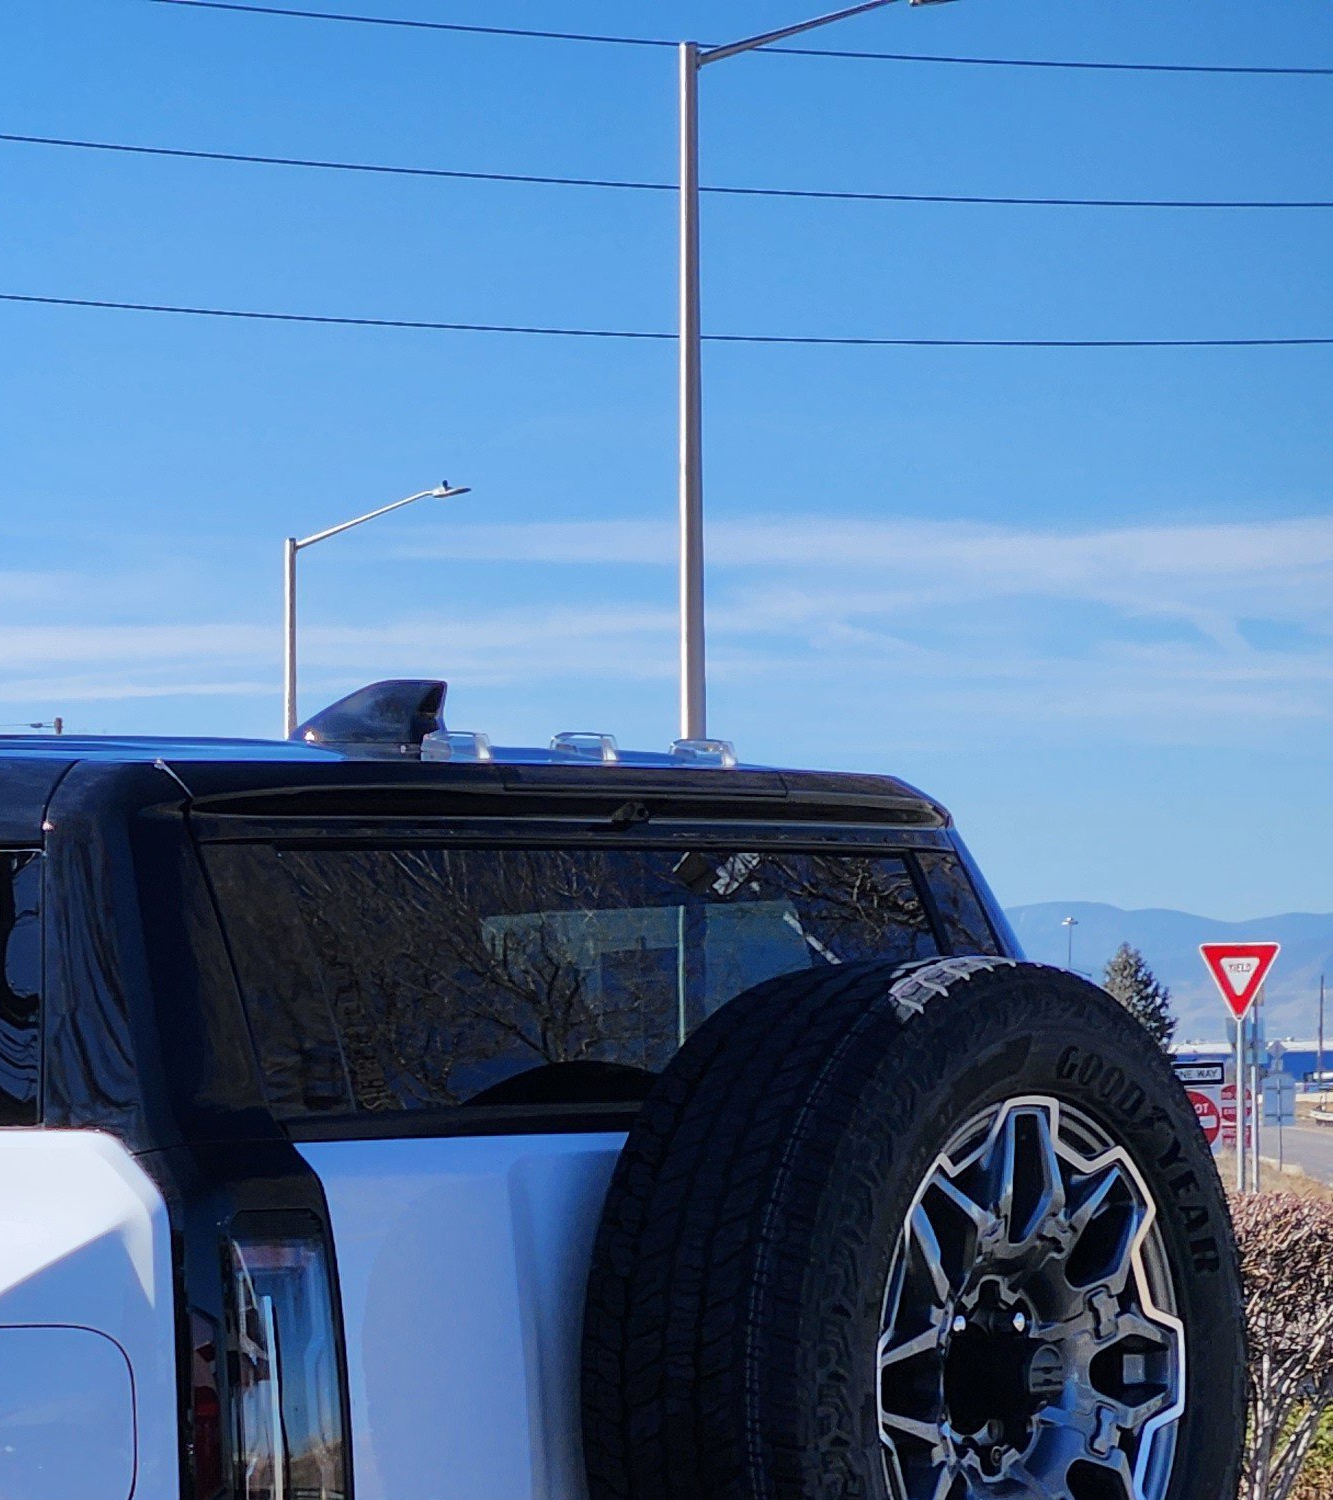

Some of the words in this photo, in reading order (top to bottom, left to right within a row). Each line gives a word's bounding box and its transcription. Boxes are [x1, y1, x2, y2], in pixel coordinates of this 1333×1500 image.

[1229, 963, 1252, 973] YIELD
[1196, 1069, 1219, 1079] WAY
[1193, 1101, 1210, 1114] OT
